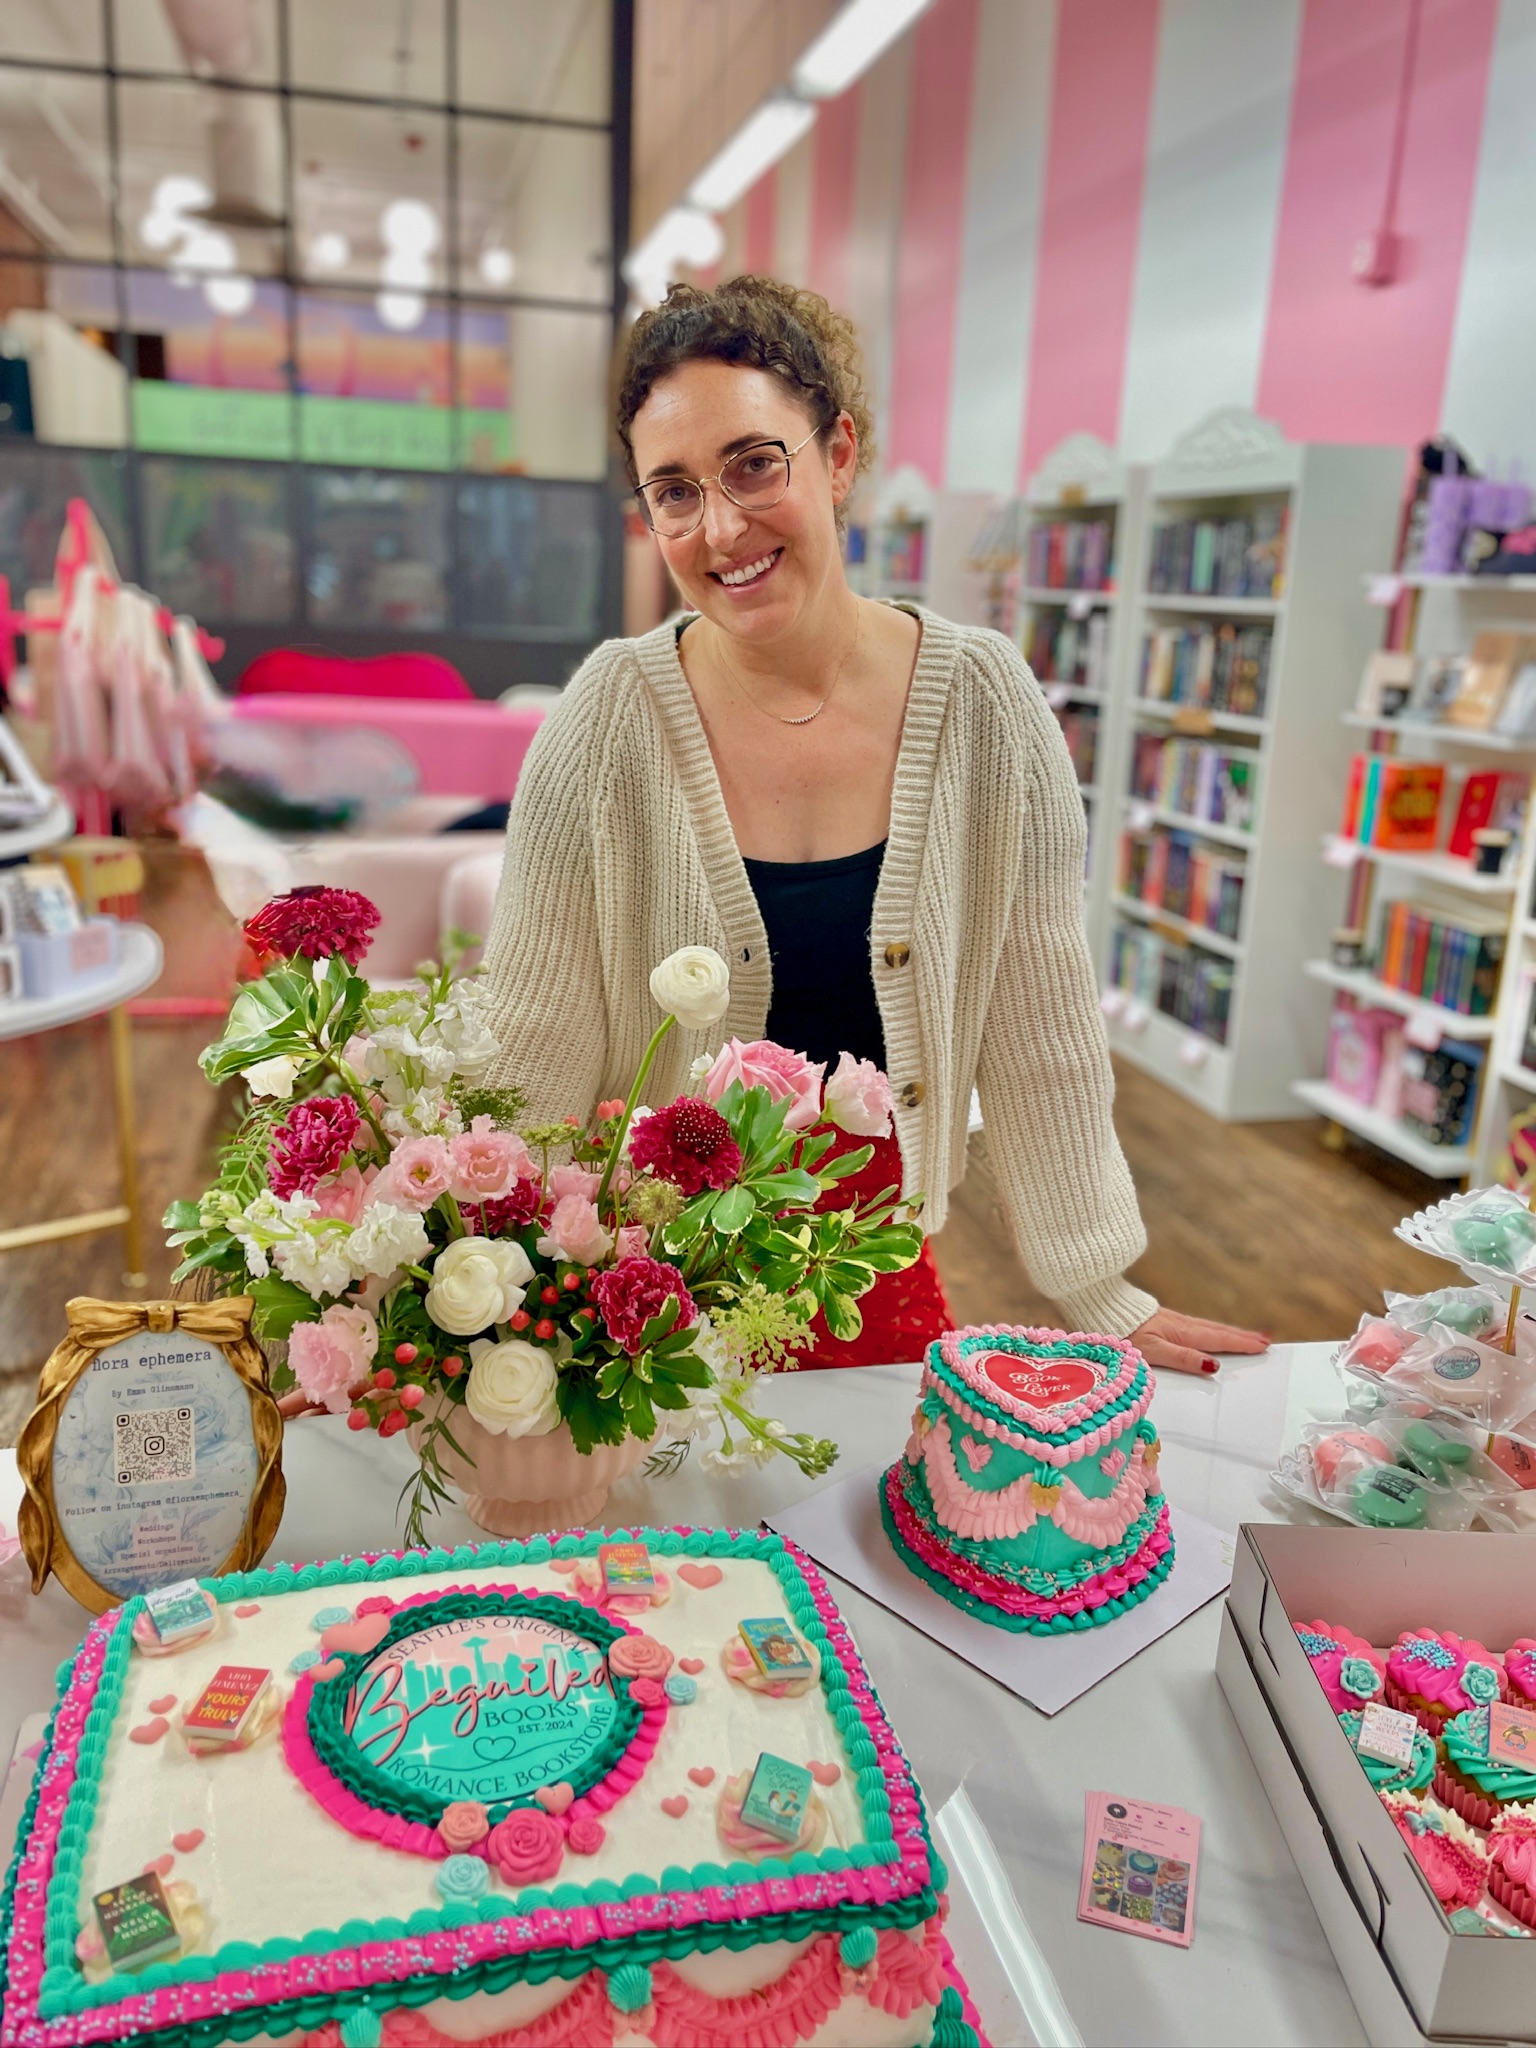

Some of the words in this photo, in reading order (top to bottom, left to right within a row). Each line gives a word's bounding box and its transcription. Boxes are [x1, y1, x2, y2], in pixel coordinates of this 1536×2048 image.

[92, 1358, 129, 1372] flora
[139, 1350, 212, 1369] ephemera
[112, 1389, 123, 1399] By
[127, 1387, 146, 1397] Emma
[65, 1506, 97, 1517] Follow
[139, 1522, 174, 1533] Weddings
[137, 1534, 177, 1546] Workshops
[120, 1551, 151, 1562] Special
[388, 1617, 486, 1662] SEATTLE'S
[493, 1618, 594, 1659] ORIGINAL
[205, 1692, 250, 1706] YOURS
[198, 1707, 239, 1721] TRULY
[484, 1701, 579, 1729] BOOKS
[387, 1756, 508, 1797] ROMANCE
[514, 1705, 613, 1788] BOOKSTORE
